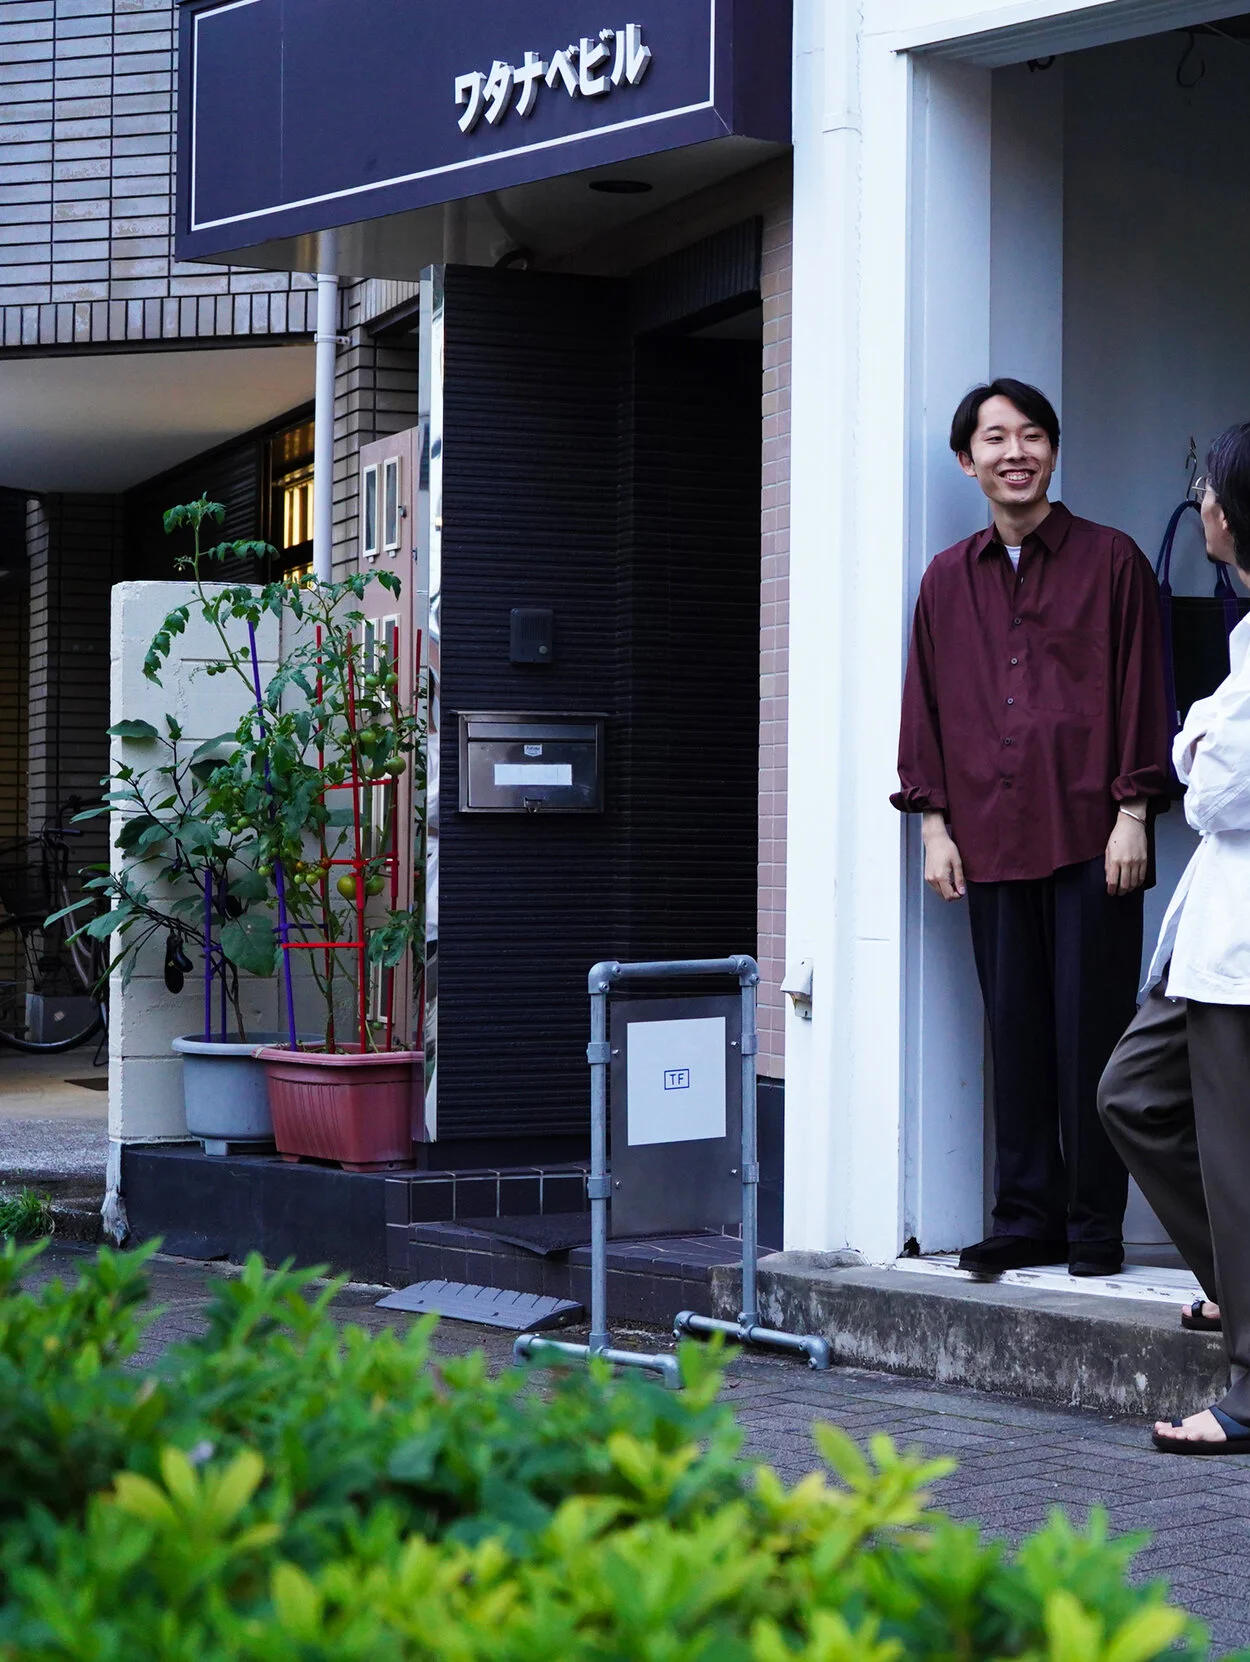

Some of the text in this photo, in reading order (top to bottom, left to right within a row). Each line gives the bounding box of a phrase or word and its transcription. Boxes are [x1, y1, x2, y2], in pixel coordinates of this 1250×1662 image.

[454, 23, 651, 133] ワタナベビル
[669, 1073, 684, 1085] TF
